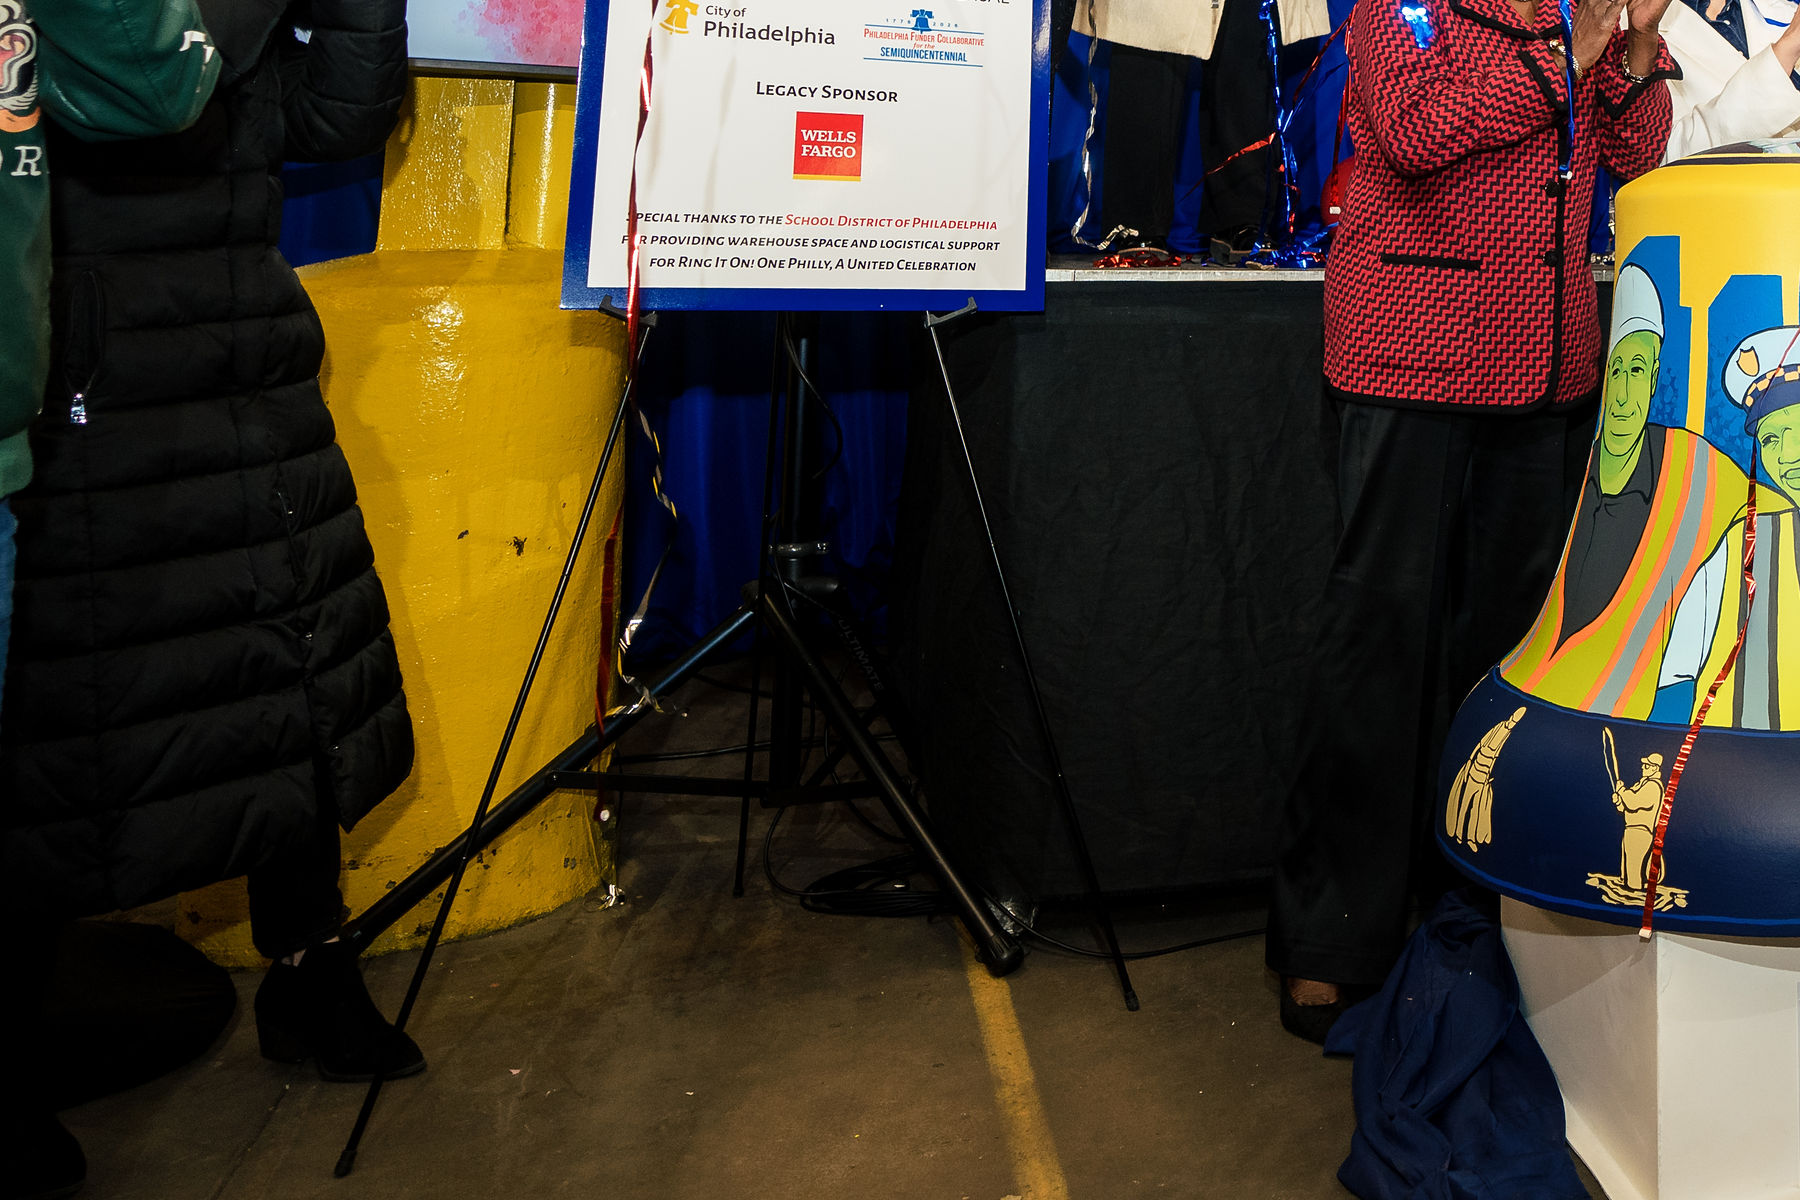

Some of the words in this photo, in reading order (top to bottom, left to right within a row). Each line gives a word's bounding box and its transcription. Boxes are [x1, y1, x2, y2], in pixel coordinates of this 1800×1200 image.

[706, 5, 731, 18] City
[733, 7, 747, 18] of
[704, 21, 836, 46] Philadelphia
[863, 28, 909, 41] PHILADELPHIA
[910, 31, 935, 43] FUNDER
[937, 33, 985, 47] COLLABORATIVE
[880, 47, 968, 62] SEMIQUINCENTENNIAL
[756, 81, 818, 98] LEGACY
[821, 85, 898, 102] SPONSOR
[800, 129, 857, 143] WELLS
[801, 145, 857, 158] FARGO
[683, 213, 737, 224] THANKS
[739, 214, 756, 224] TO
[758, 215, 783, 225] THE
[785, 214, 835, 226] SCHOOL
[837, 215, 893, 228] DISTRICT
[894, 218, 911, 228] OF
[912, 217, 998, 230] PHILADELPHIA
[621, 235, 648, 245] FR
[650, 235, 725, 246] PROVIDING
[727, 236, 810, 248] WAREHOUSE
[811, 238, 849, 248] SPACE
[850, 239, 878, 249] AND
[879, 239, 945, 250] LOGISTICAL
[947, 241, 1001, 251] SUPPORT
[649, 258, 675, 268] FOR
[678, 256, 712, 268] RING
[715, 256, 728, 268] IT
[729, 257, 754, 269] ON!
[757, 257, 786, 269] ONE
[835, 259, 845, 270] A
[847, 259, 894, 271] UNITED
[896, 259, 976, 272] CELEBRATION
